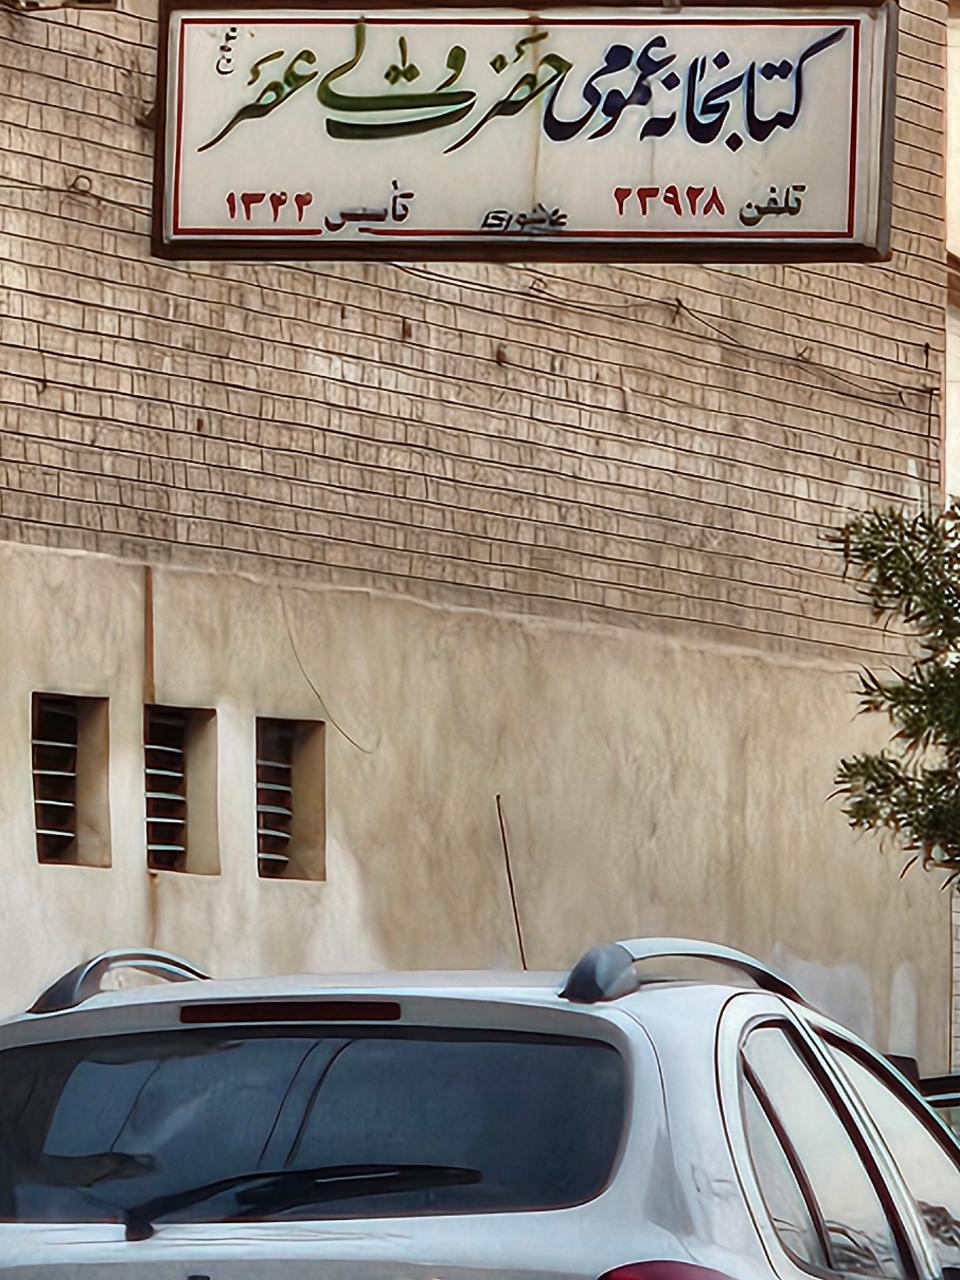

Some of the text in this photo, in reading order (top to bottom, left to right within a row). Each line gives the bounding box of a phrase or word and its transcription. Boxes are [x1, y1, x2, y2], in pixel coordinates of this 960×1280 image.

[197, 49, 319, 153] عصر
[317, 16, 477, 112] ولی
[326, 31, 573, 154] حضرت
[543, 35, 677, 141] عمومی
[640, 27, 847, 152] کتابخانه
[739, 184, 806, 227] تلفن
